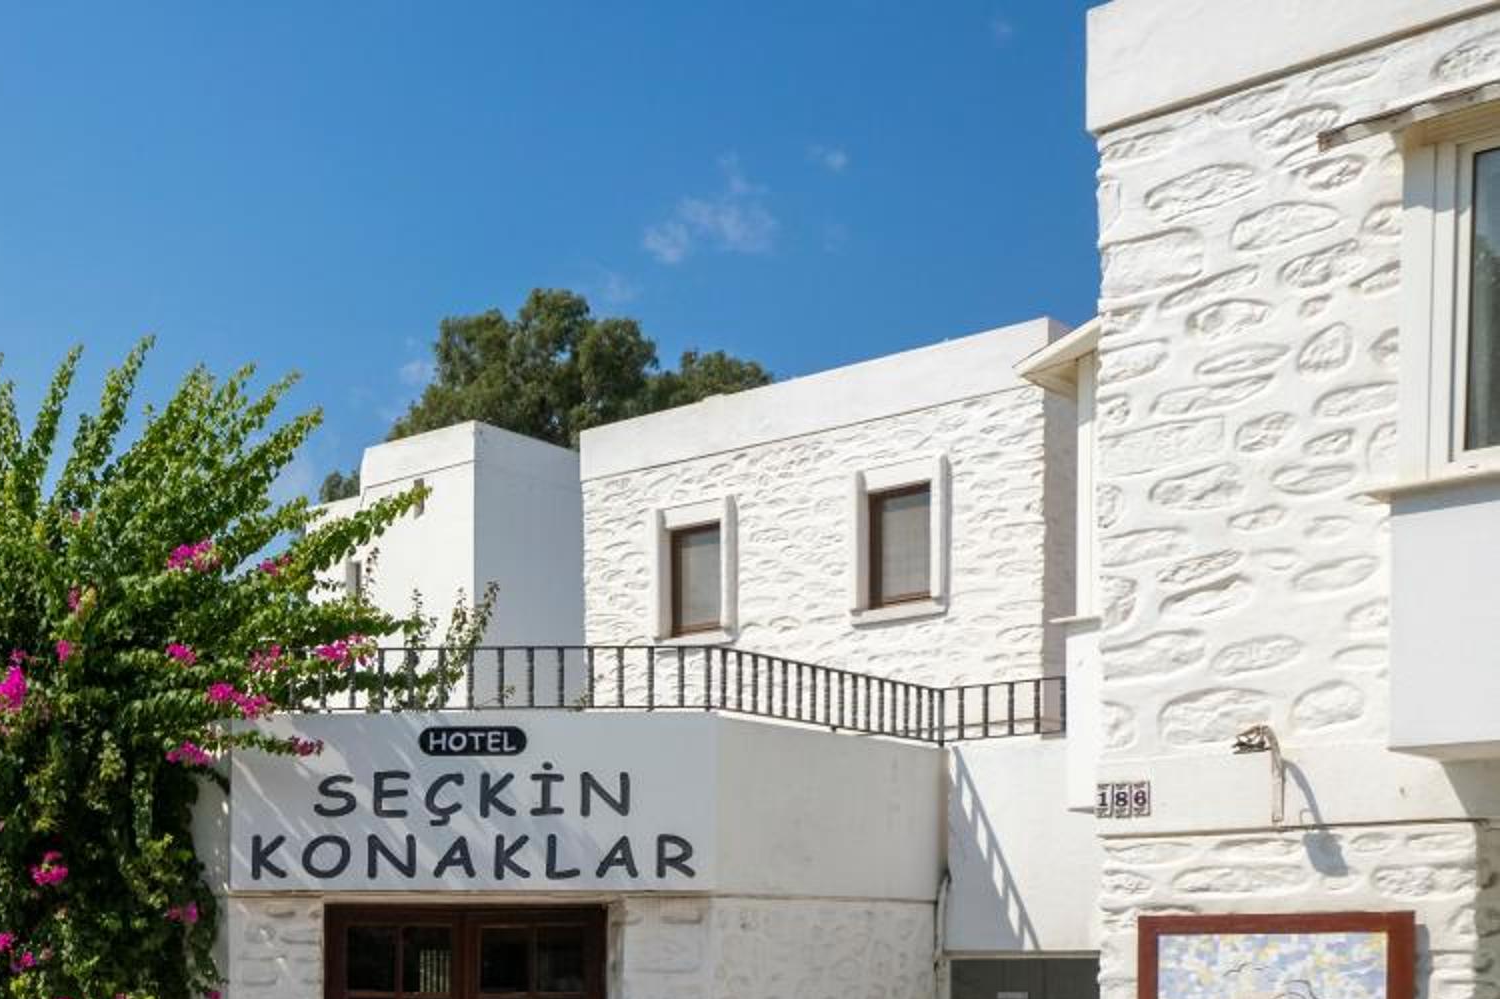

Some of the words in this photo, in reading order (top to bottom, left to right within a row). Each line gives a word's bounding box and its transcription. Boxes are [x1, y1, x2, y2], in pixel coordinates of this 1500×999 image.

[428, 731, 517, 752] HOTEL
[313, 761, 631, 827] SEÇKİN
[250, 833, 696, 881] KONAKLAR
